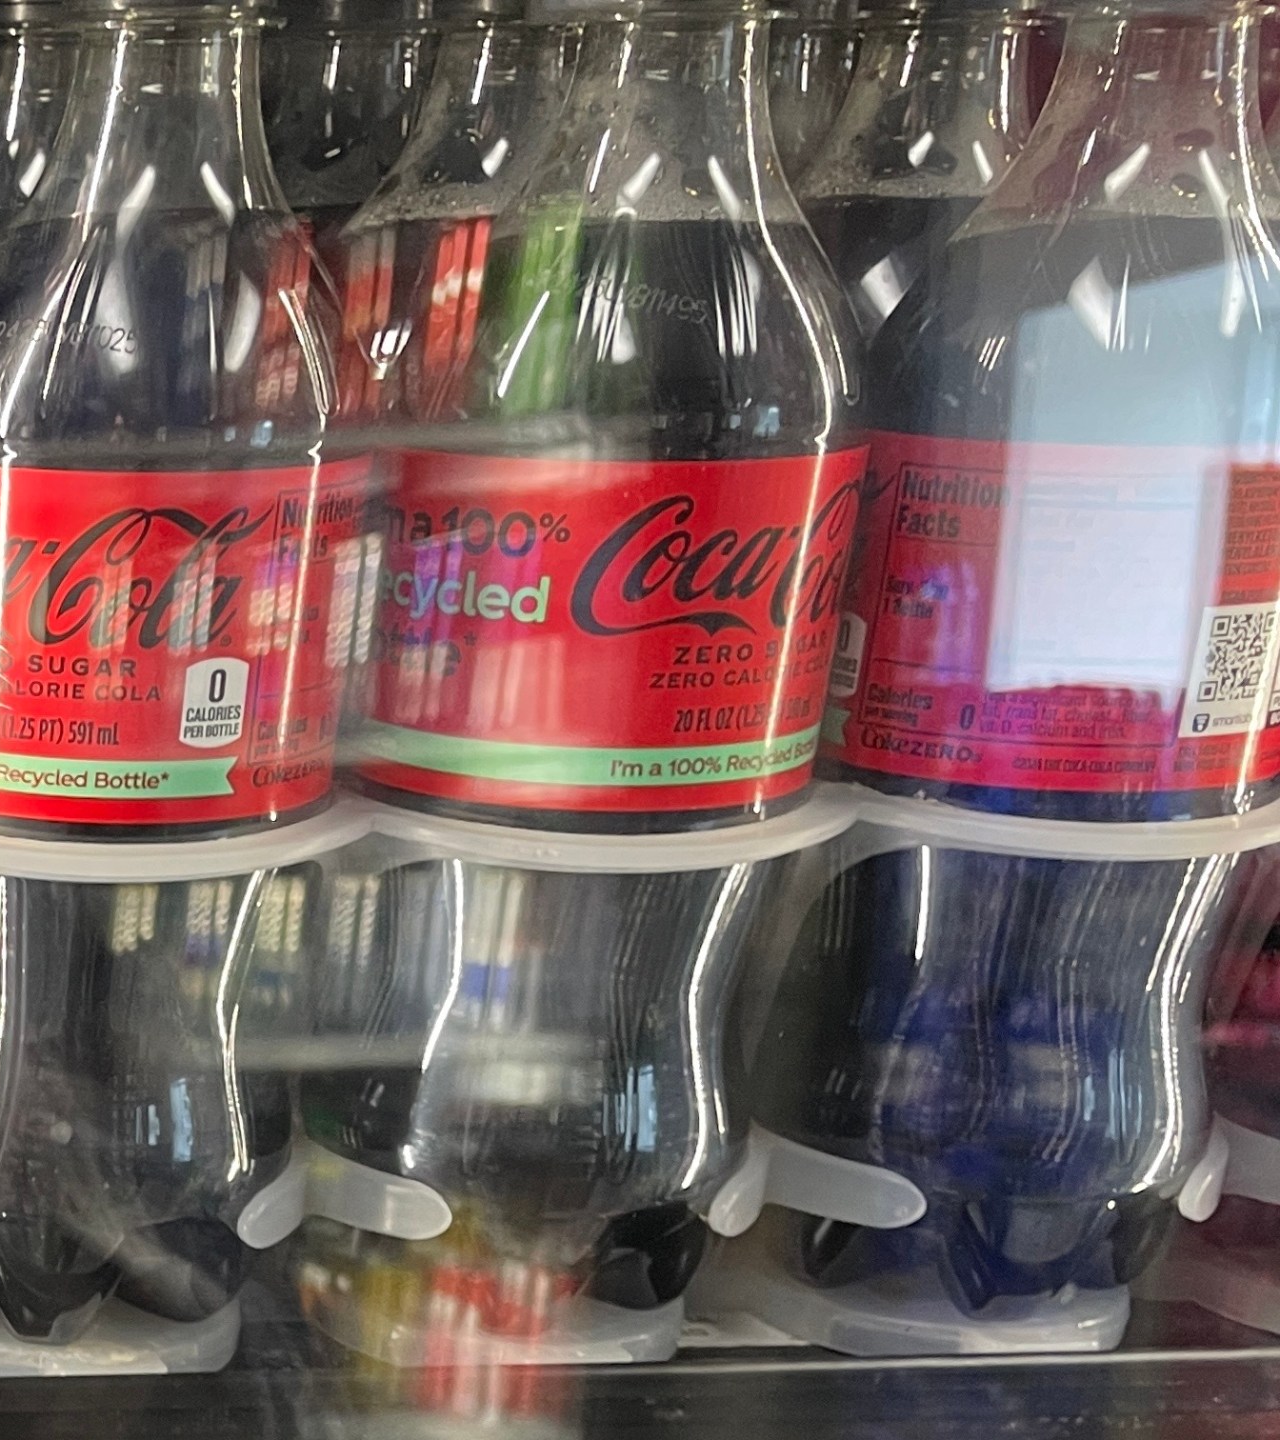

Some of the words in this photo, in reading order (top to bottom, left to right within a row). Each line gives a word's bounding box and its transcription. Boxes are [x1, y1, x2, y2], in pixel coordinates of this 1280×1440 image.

[443, 506, 571, 557] 100%
[897, 509, 961, 539] Facts
[27, 654, 138, 678] SUGAR
[673, 644, 753, 666] ZERO
[95, 684, 162, 702] COLA
[208, 669, 227, 702] 0
[649, 671, 715, 689] ZERO
[185, 705, 241, 722] CALORIES
[673, 709, 692, 733] 20
[696, 707, 711, 732] FL
[715, 705, 734, 731] OZ
[959, 703, 976, 731] 0
[39, 716, 65, 746] PT)
[67, 719, 95, 744] 591
[96, 722, 120, 746] mL
[183, 723, 205, 739] PER
[205, 722, 240, 738] BOTTLE
[610, 759, 644, 777] I'm
[649, 761, 662, 777] a
[668, 757, 722, 776] 100%
[727, 748, 793, 772] Recycled
[911, 738, 972, 763] ZERO
